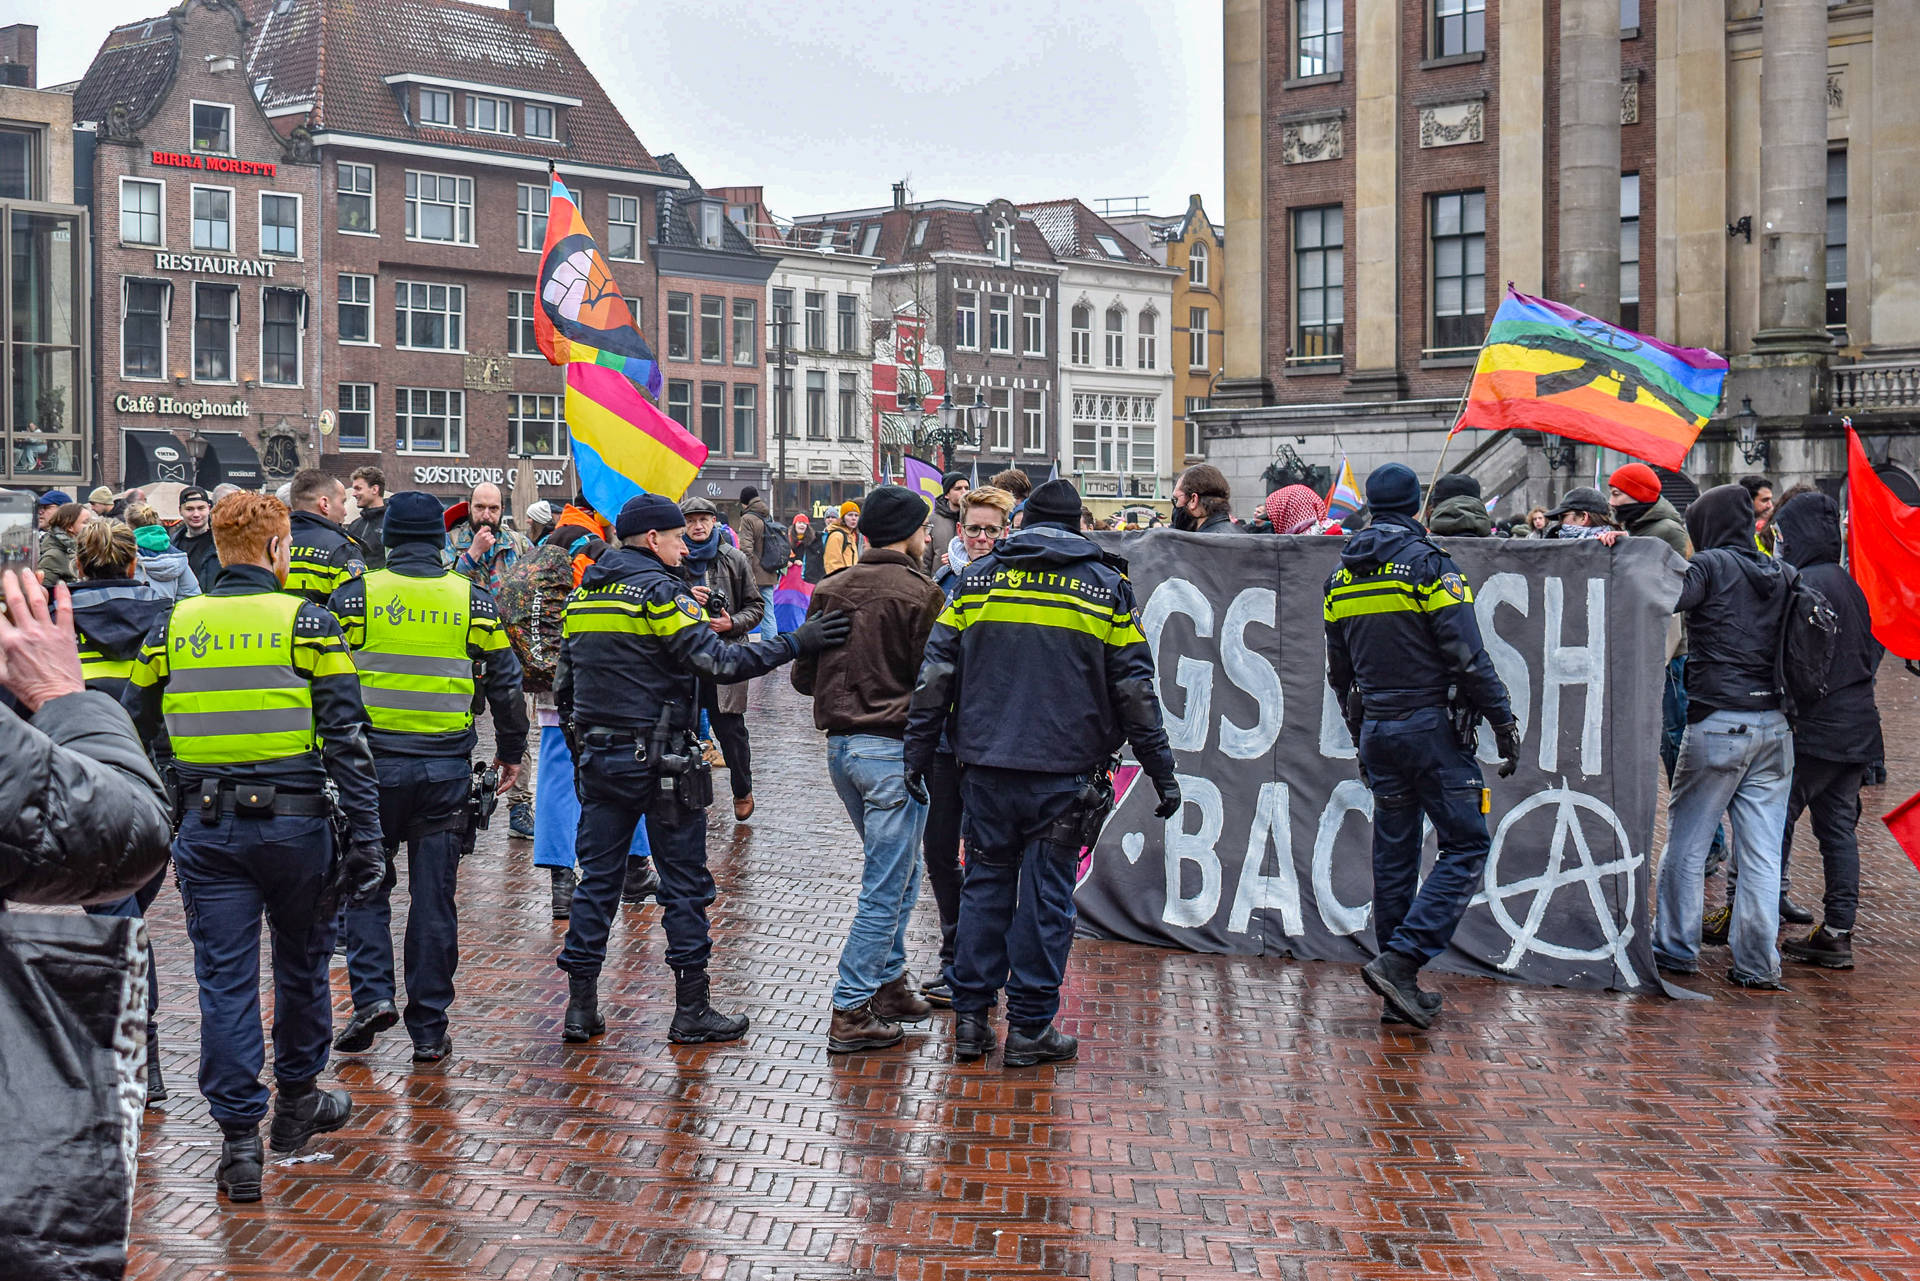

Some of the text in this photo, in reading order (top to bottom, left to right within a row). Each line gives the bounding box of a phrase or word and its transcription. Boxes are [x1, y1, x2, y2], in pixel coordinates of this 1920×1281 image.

[152, 151, 277, 177] BIRRA MORETTI
[156, 253, 277, 277] RESTAURANT
[116, 394, 250, 419] Café Hooghoudt
[414, 465, 564, 490] SØSTRENE GENE
[1162, 774, 1446, 937] BAC
